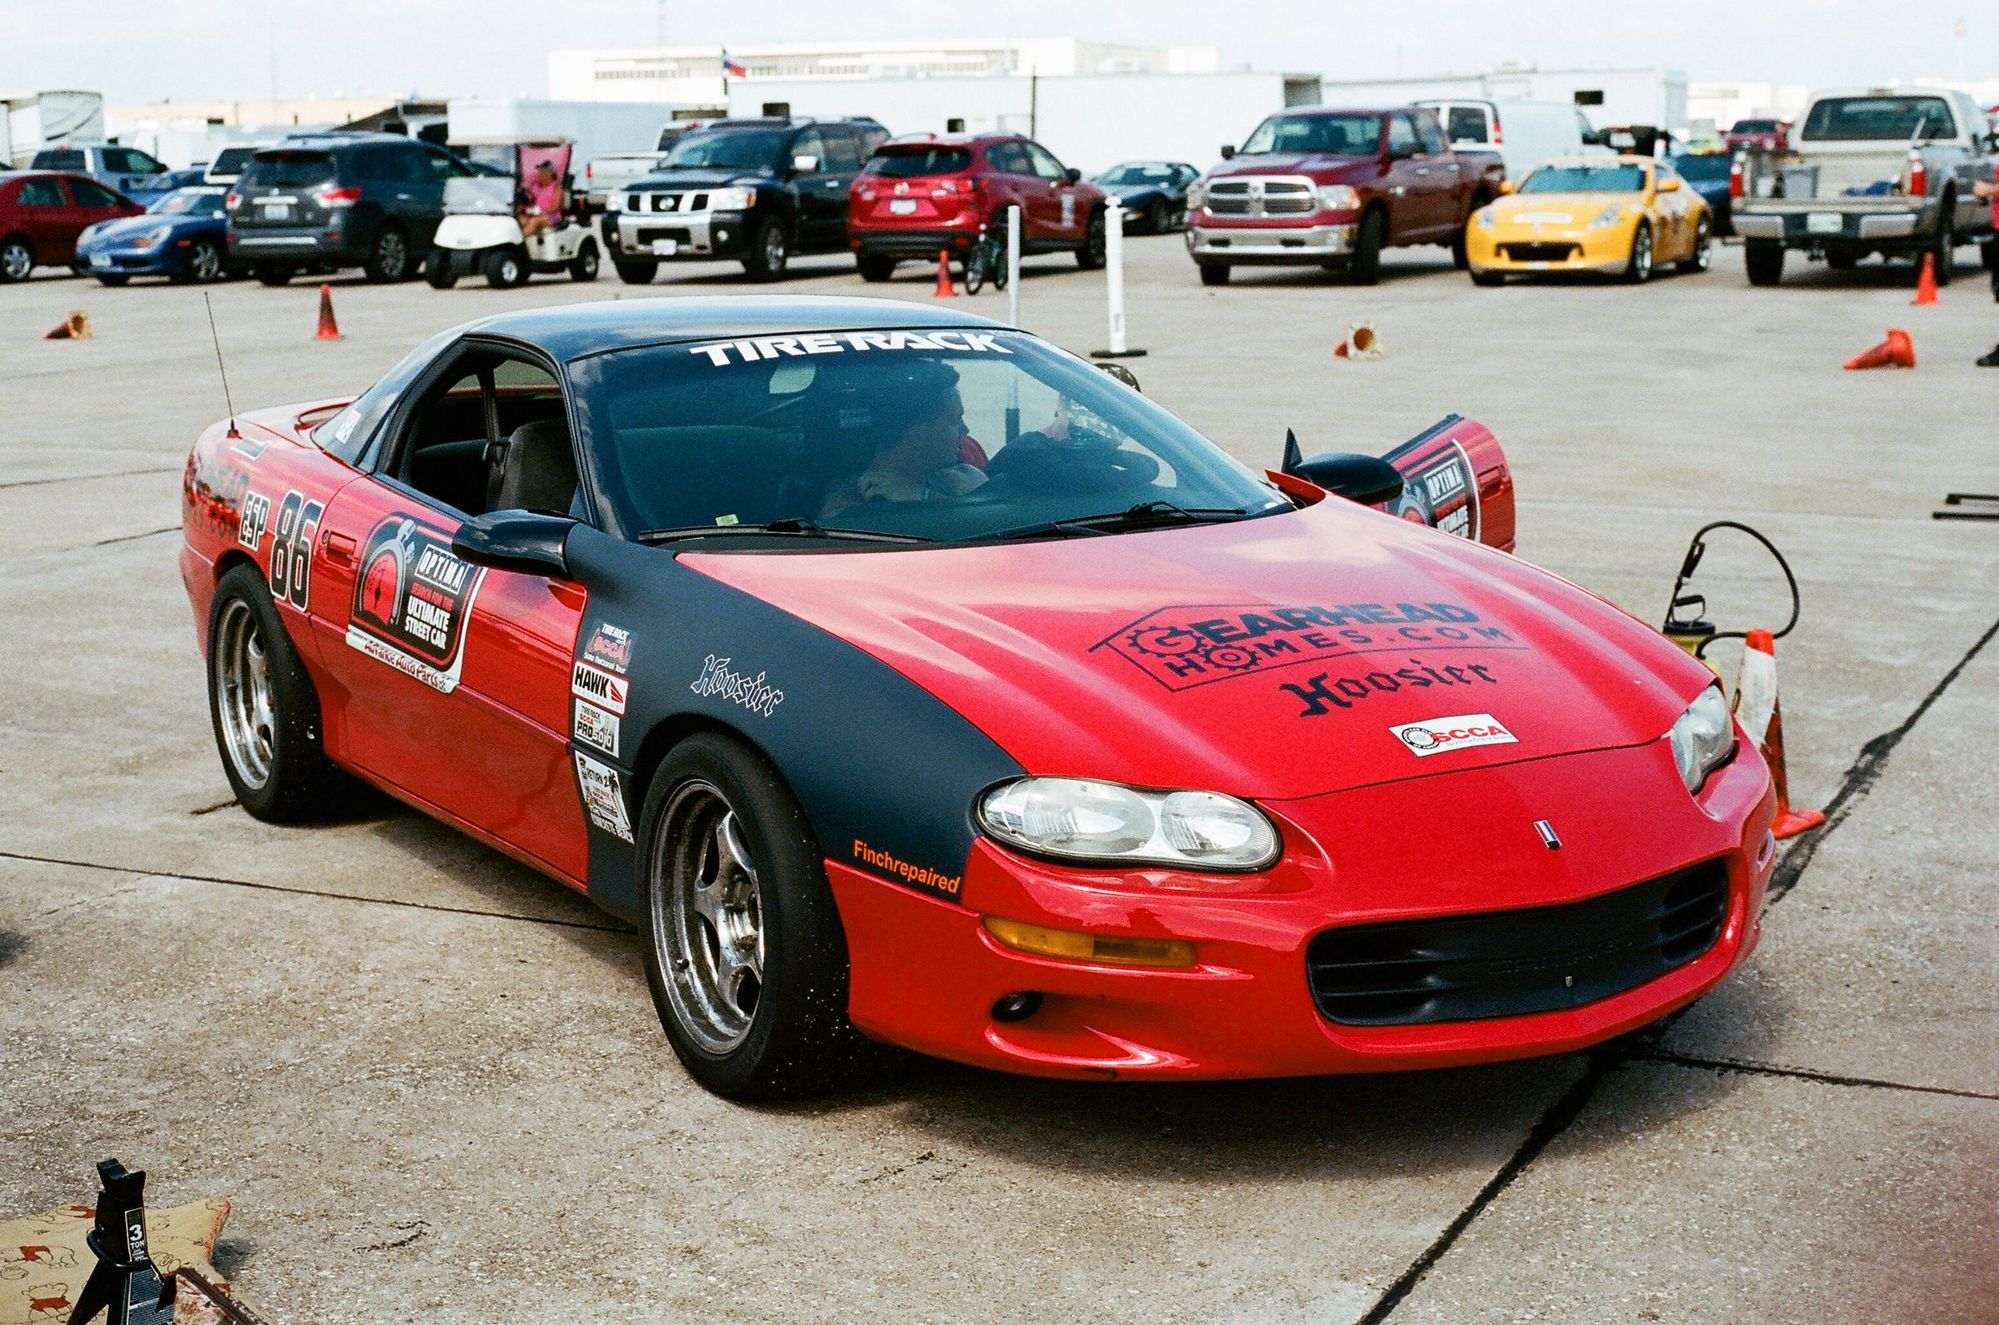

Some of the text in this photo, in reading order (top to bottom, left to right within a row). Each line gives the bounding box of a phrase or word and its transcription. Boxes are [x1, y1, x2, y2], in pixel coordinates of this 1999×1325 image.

[690, 331, 1013, 366] TIRE RACK
[269, 489, 326, 613] 86
[419, 550, 465, 588] OPTIMA
[404, 615, 447, 649] STREET CAR
[407, 595, 451, 632] ULTIMATE
[1126, 602, 1480, 658] GEARHEAD
[1164, 626, 1513, 678] HOMES.COM
[574, 665, 610, 699] HAWK
[690, 653, 784, 718] Hoosier
[1279, 657, 1497, 717] Hoosier
[1430, 725, 1508, 742] SCCA
[853, 839, 961, 894] Finchrepaired
[129, 1223, 143, 1241] 3
[130, 1240, 145, 1249] TON
